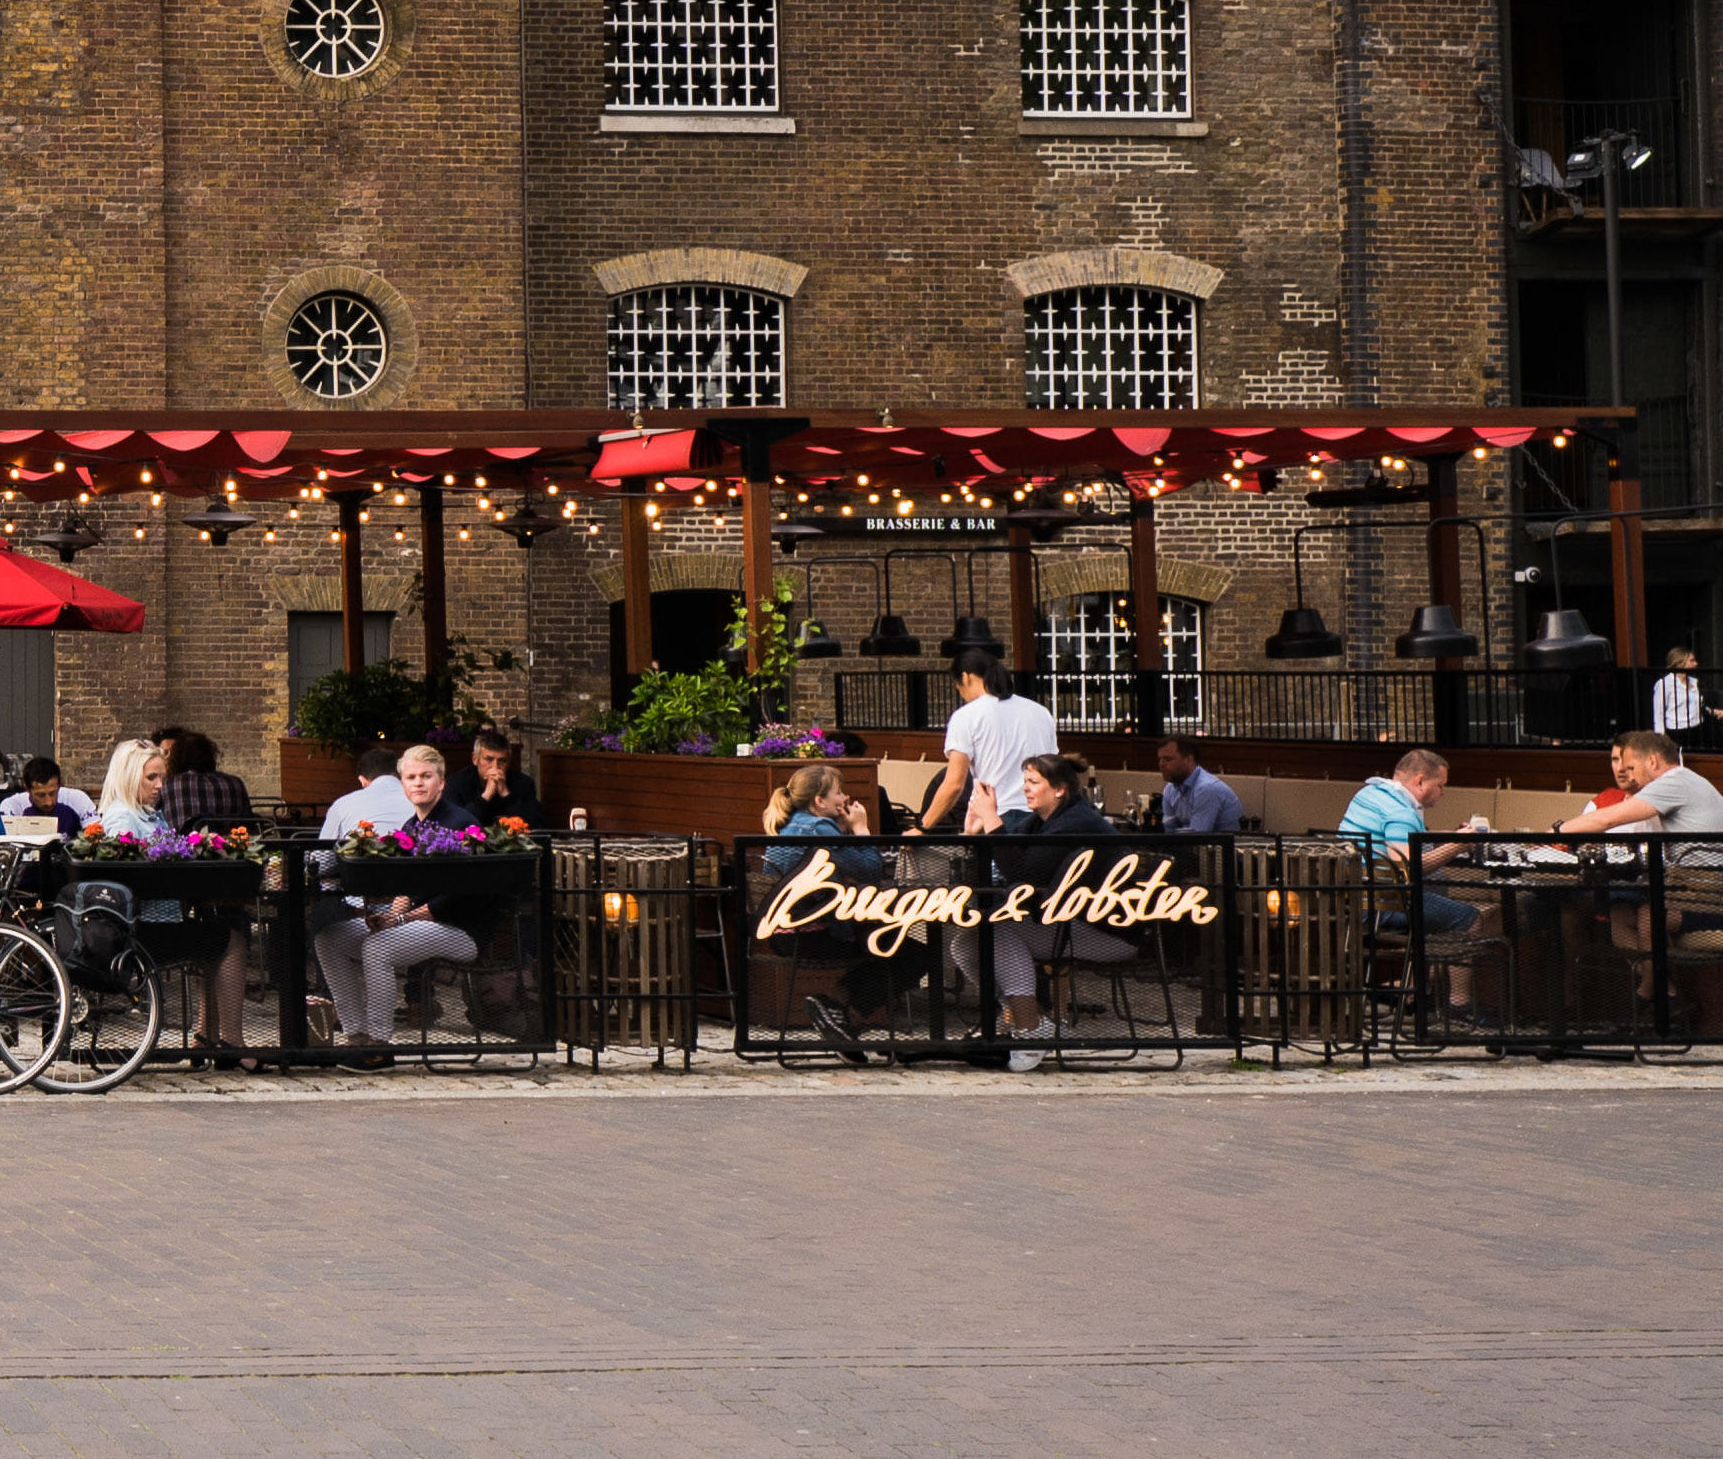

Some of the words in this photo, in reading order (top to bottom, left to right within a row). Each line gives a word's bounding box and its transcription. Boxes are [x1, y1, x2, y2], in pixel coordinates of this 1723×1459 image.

[866, 518, 945, 530] BRASSERIE
[950, 518, 961, 530] &
[967, 518, 996, 530] BAR
[756, 848, 982, 958] Burger
[988, 884, 1035, 922] &
[1040, 849, 1219, 927] lobster
